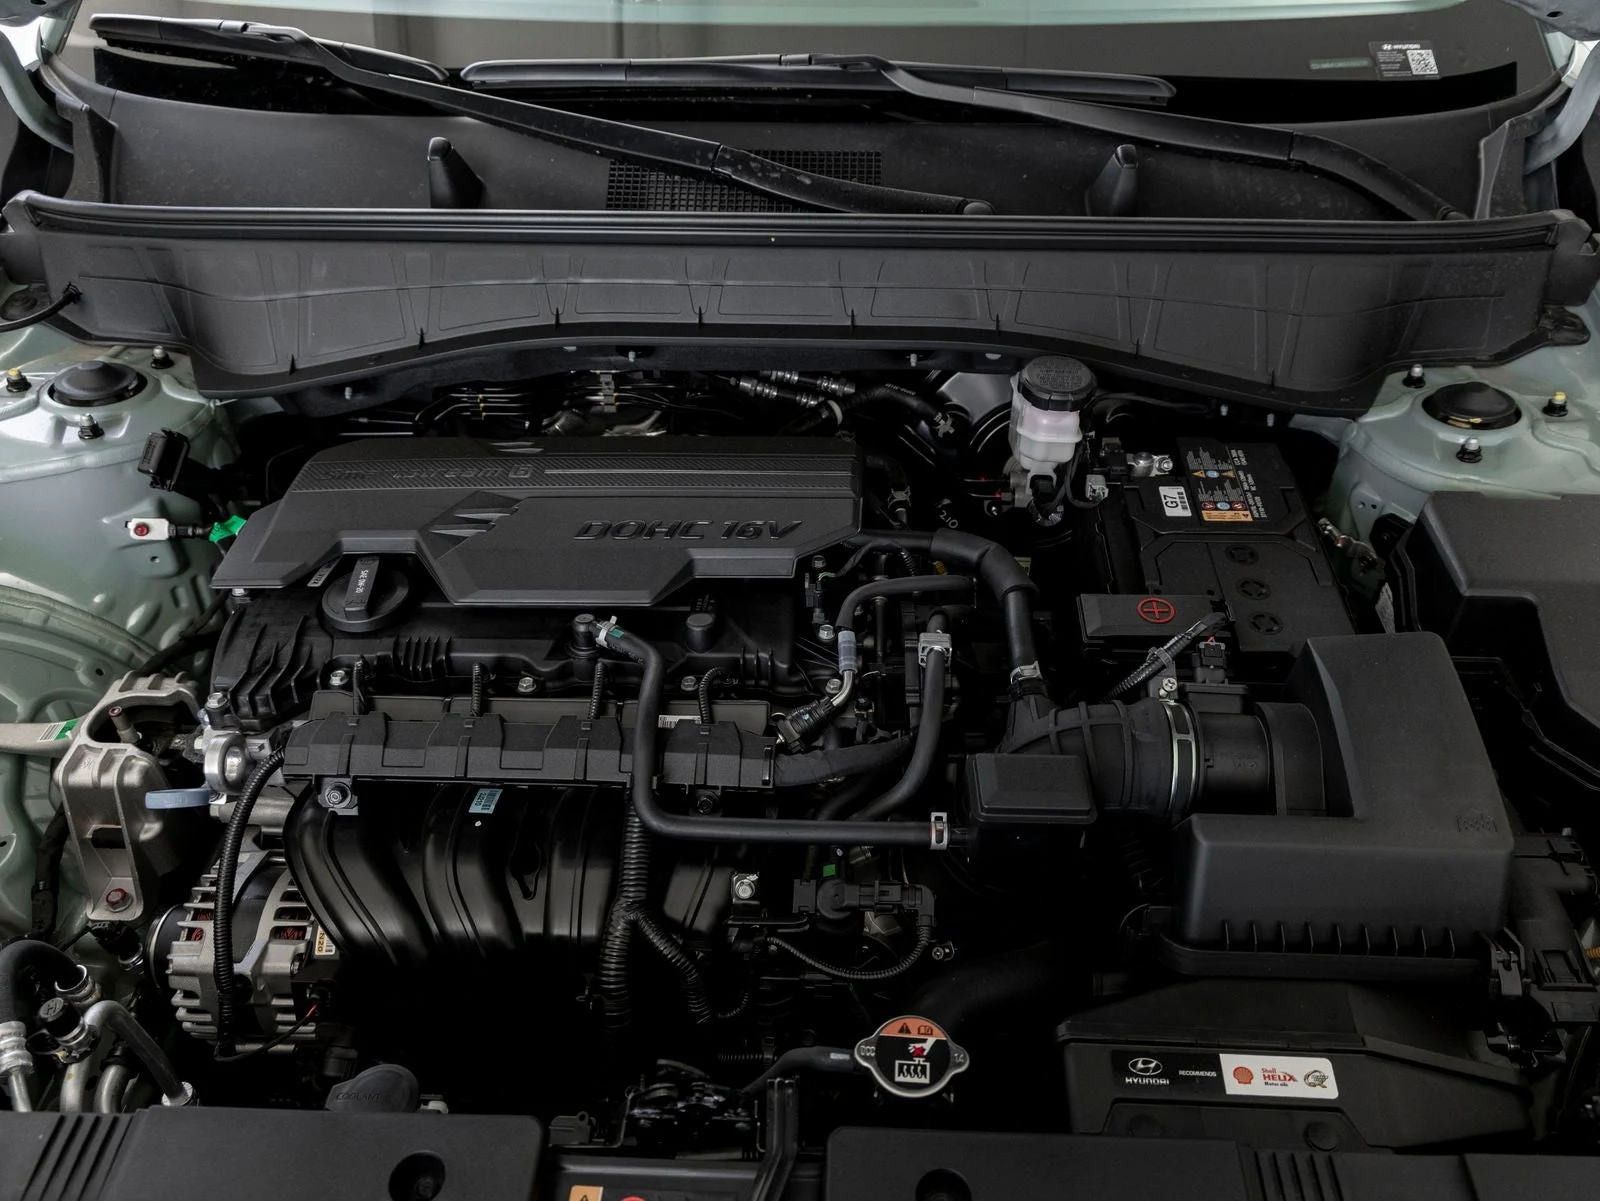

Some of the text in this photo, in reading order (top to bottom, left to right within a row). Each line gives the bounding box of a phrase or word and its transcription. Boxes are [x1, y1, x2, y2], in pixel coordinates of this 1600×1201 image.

[1164, 494, 1179, 509] G7
[573, 519, 802, 540] DOHC 16V
[1125, 1069, 1217, 1085] HYUNDAI RECOMMENDS
[1262, 1072, 1298, 1082] HELIX
